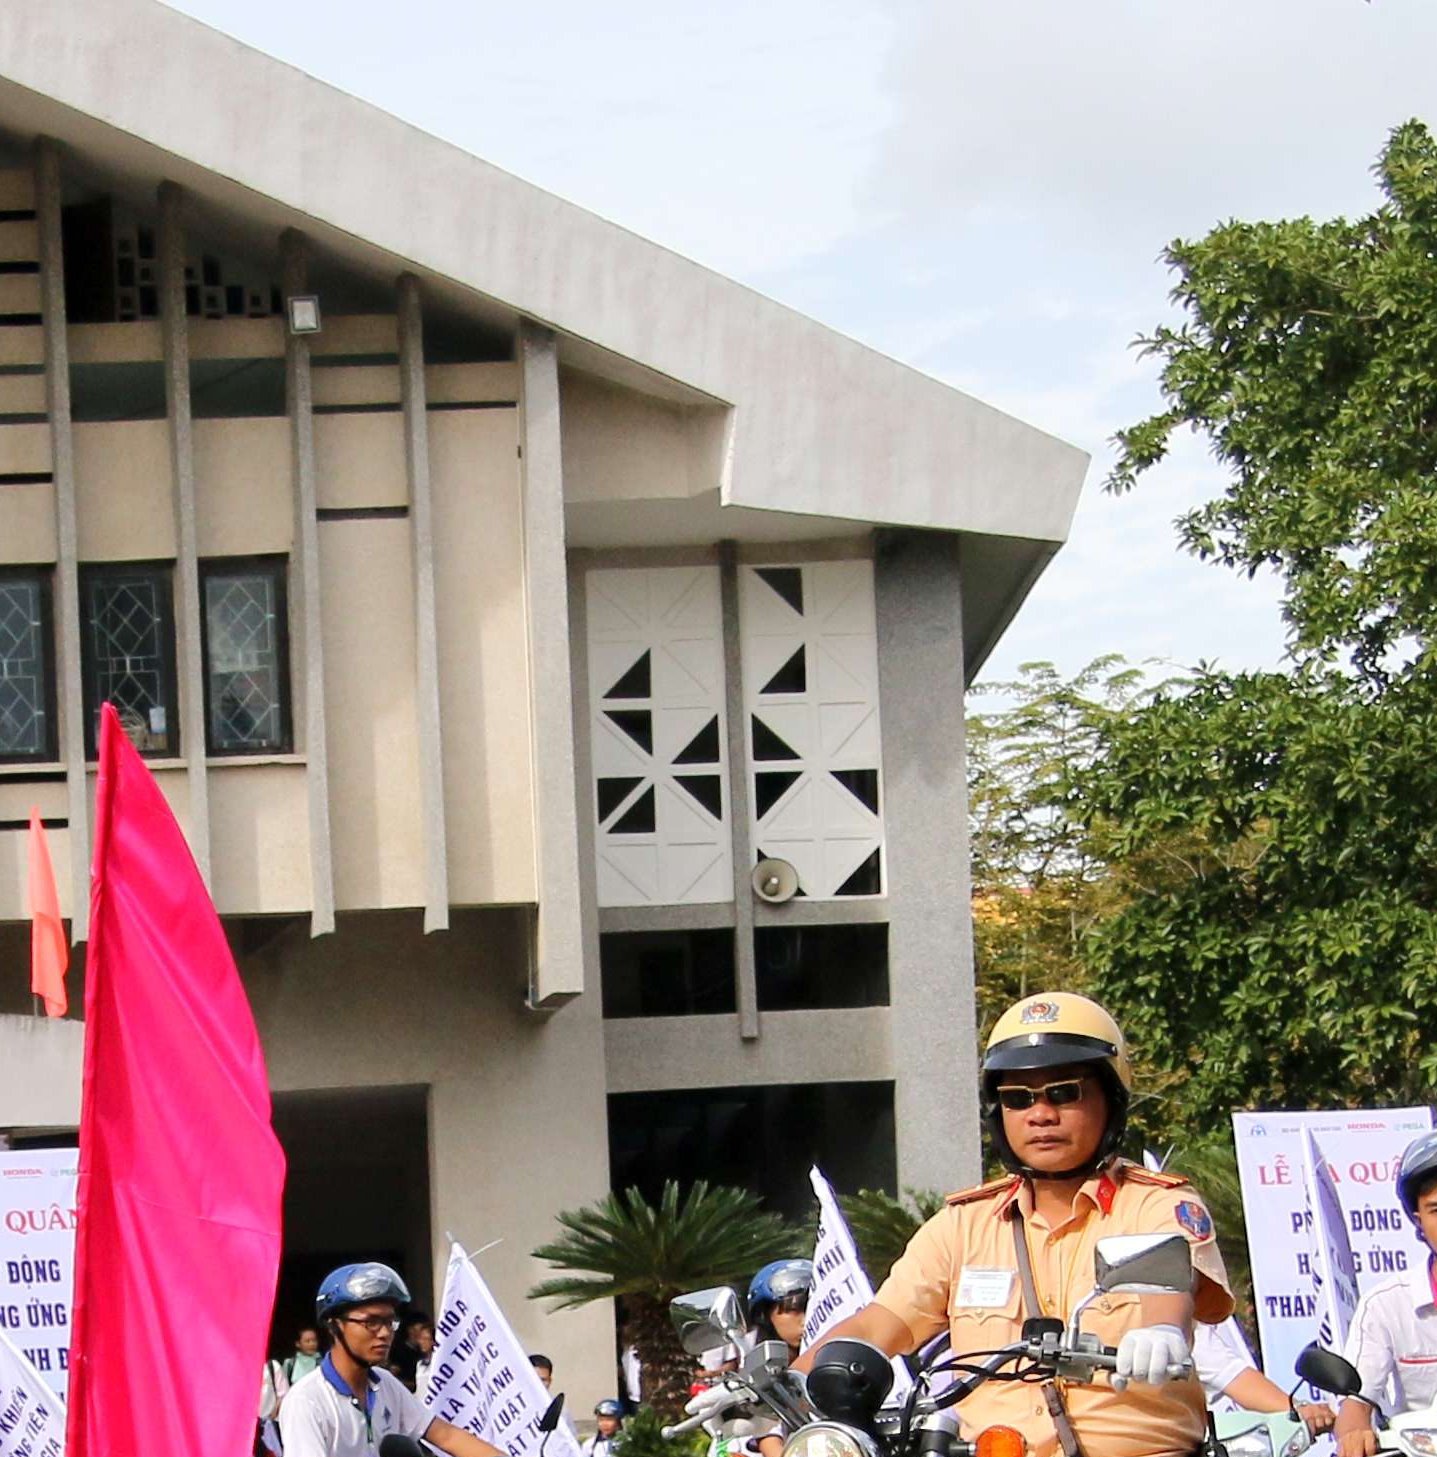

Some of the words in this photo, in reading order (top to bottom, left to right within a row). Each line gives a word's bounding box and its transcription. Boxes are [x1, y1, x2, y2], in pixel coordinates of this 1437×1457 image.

[1258, 1154, 1292, 1185] LỄ
[1349, 1155, 1403, 1184] QUÂ
[1350, 1203, 1402, 1237] ĐỘNG
[8, 1254, 61, 1289] ĐỘNG
[1368, 1243, 1407, 1274] ỨNG
[27, 1297, 69, 1327] ỨNG
[1265, 1289, 1315, 1318] THÁN
[424, 1363, 454, 1406] GIAO
[440, 1397, 465, 1423] LÀ
[493, 1392, 526, 1434] LUẬT
